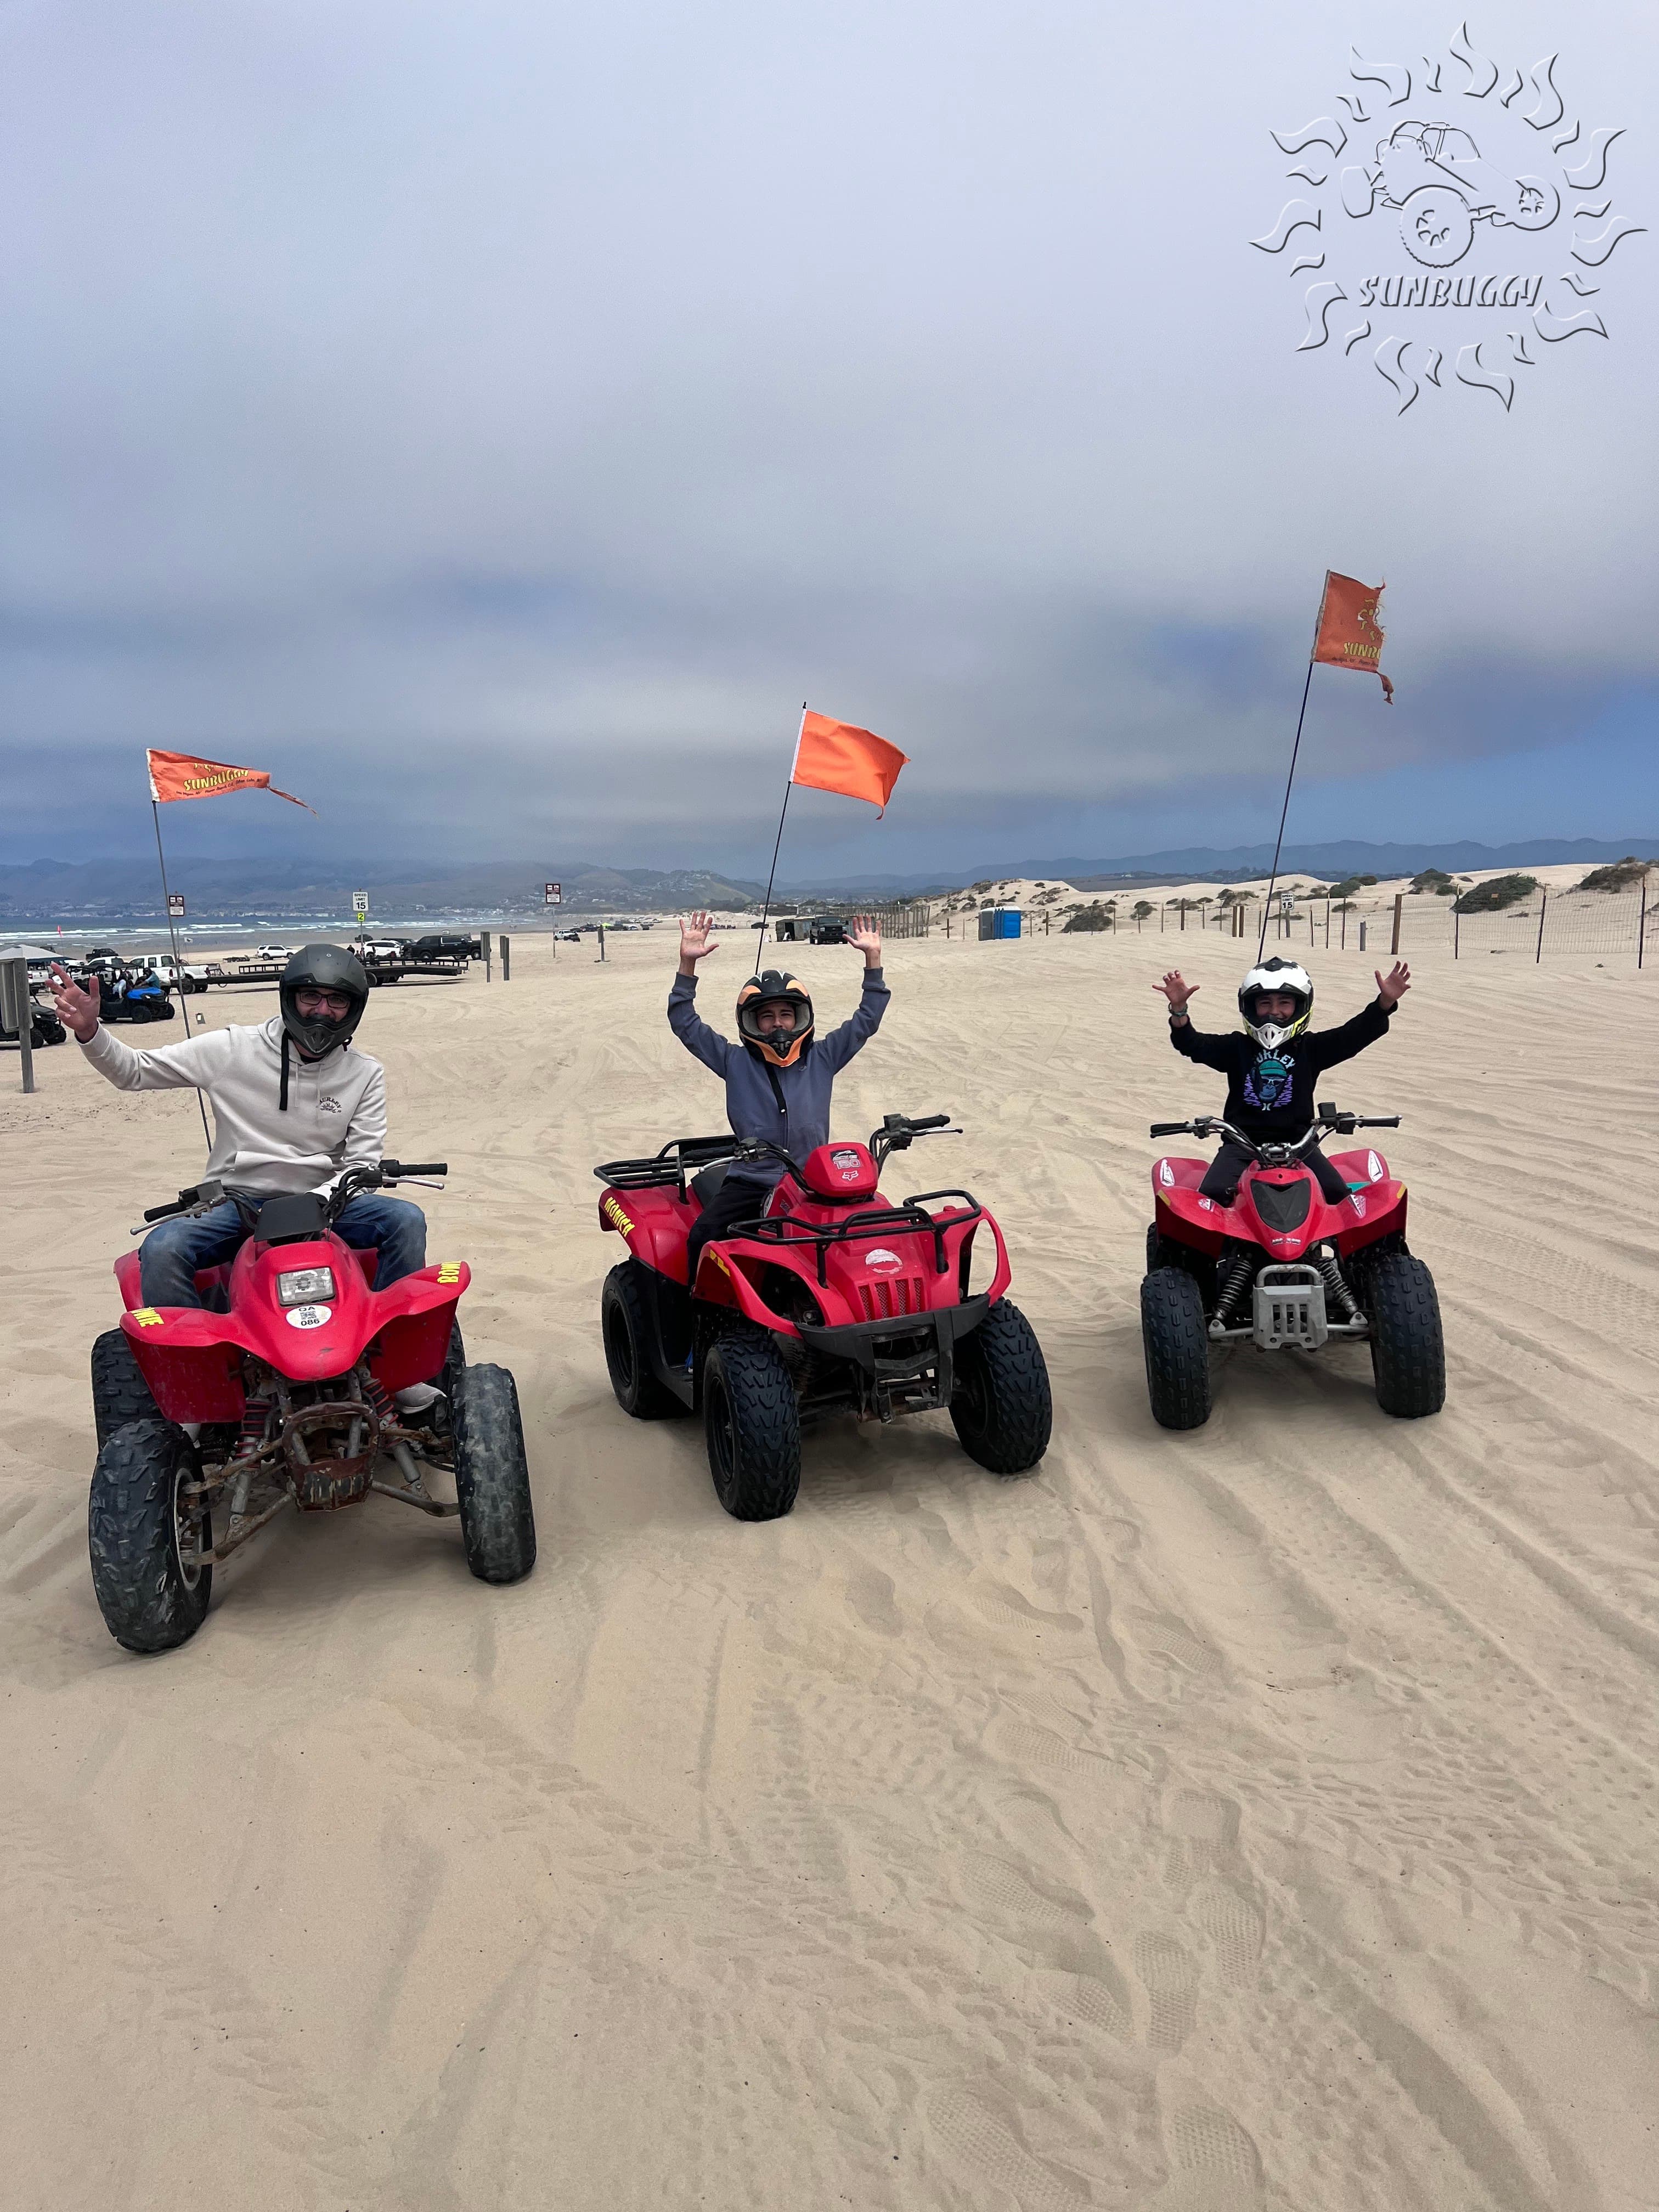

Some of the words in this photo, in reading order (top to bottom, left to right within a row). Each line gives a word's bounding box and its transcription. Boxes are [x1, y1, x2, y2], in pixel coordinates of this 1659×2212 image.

[184, 770, 249, 791] SUNBUGGY
[1255, 1048, 1295, 1069] URLEY
[604, 1197, 636, 1238] MONICA
